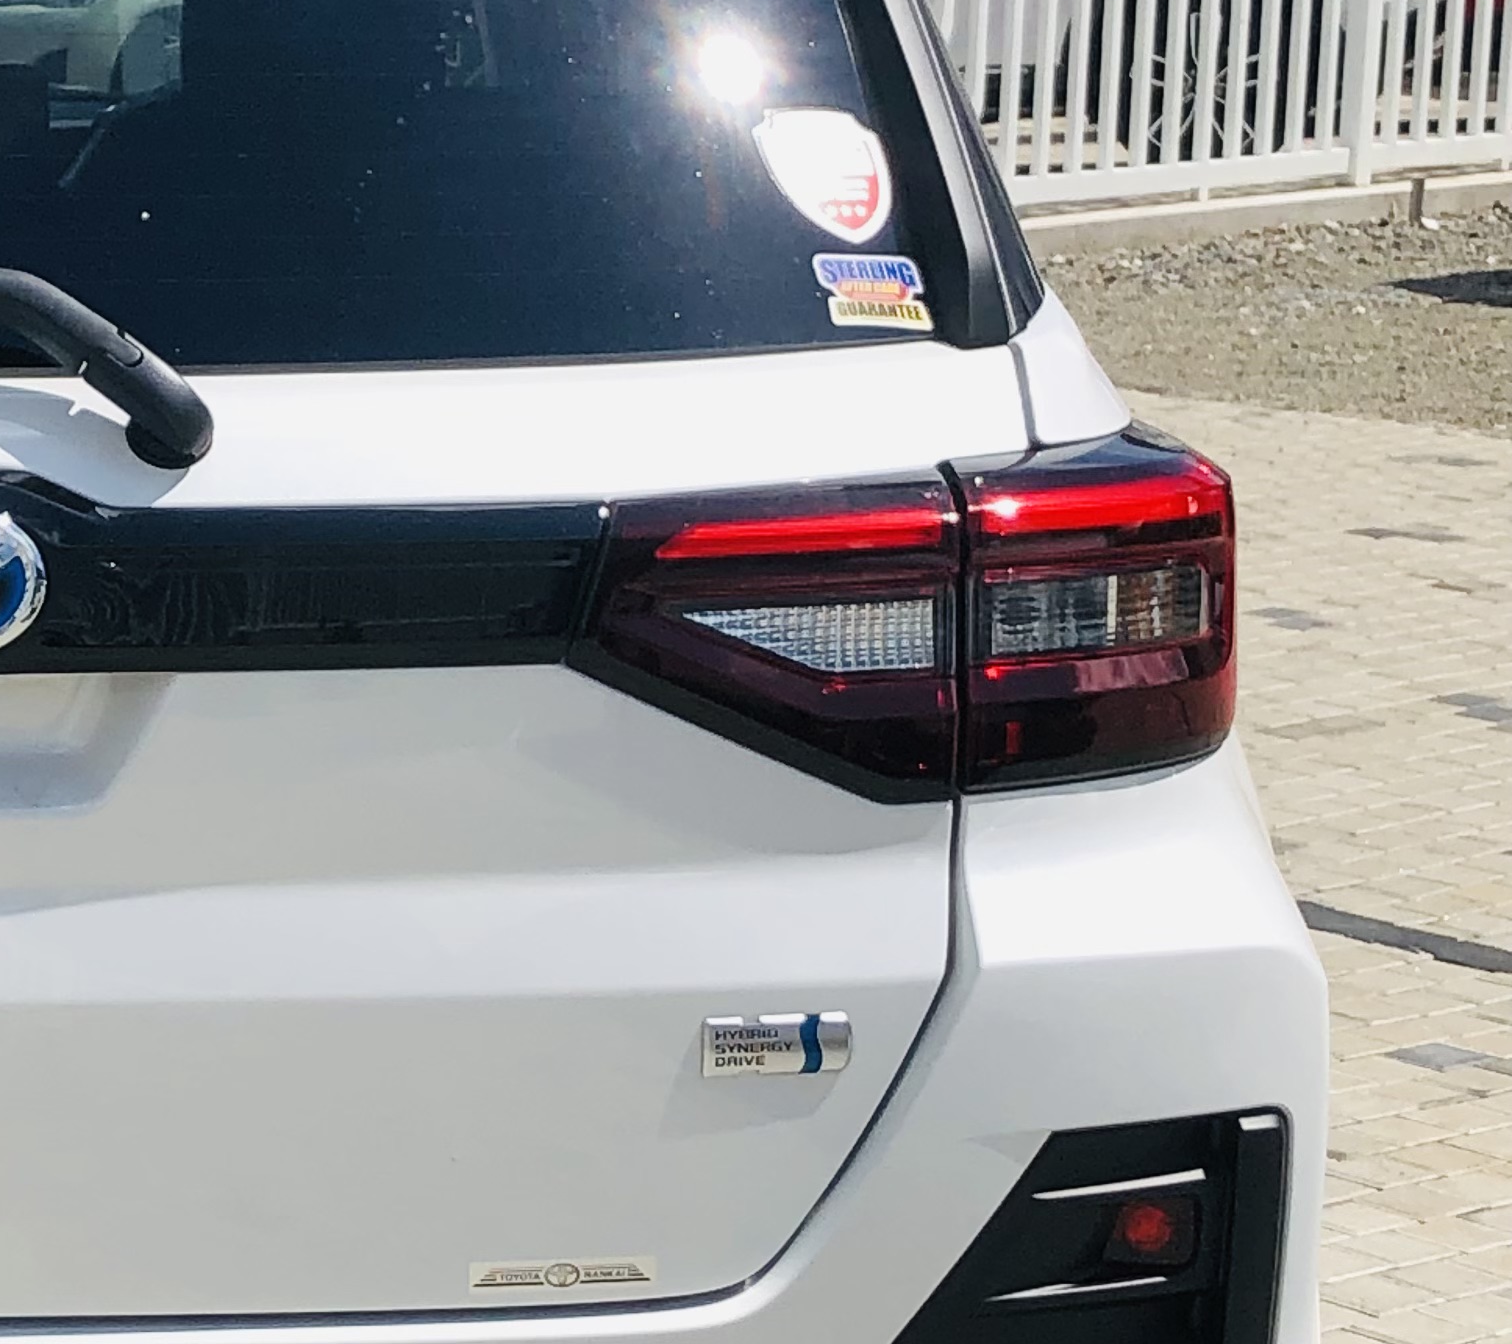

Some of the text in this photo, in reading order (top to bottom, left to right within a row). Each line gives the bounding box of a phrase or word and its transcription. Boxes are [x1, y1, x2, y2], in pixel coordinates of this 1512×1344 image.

[821, 259, 916, 287] STERLING
[838, 301, 923, 320] GUARANTEE
[715, 1029, 779, 1041] HYBRID
[715, 1042, 793, 1054] SYNERGY
[715, 1055, 766, 1067] DRIVE
[499, 1272, 541, 1282] TOYOTA
